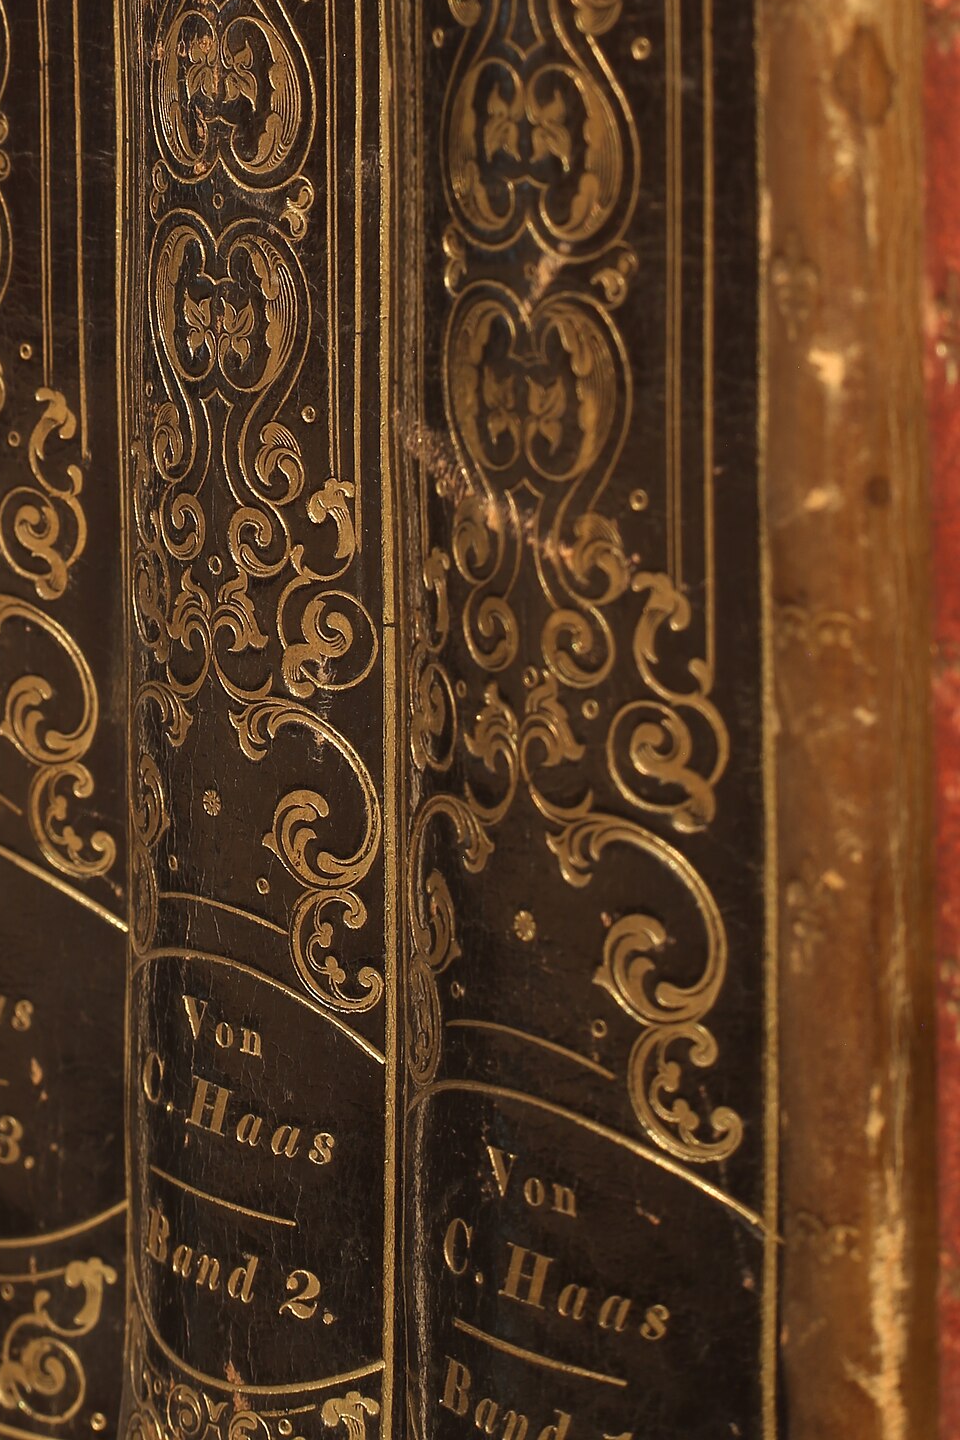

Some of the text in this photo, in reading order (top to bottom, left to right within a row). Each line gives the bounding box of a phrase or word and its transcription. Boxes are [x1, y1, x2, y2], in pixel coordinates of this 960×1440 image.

[181, 994, 264, 1060] Von
[142, 1051, 337, 1166] C. Haas
[486, 1145, 578, 1219] Von
[145, 1206, 338, 1326] Band 2.
[443, 1217, 671, 1342] C. Haas
